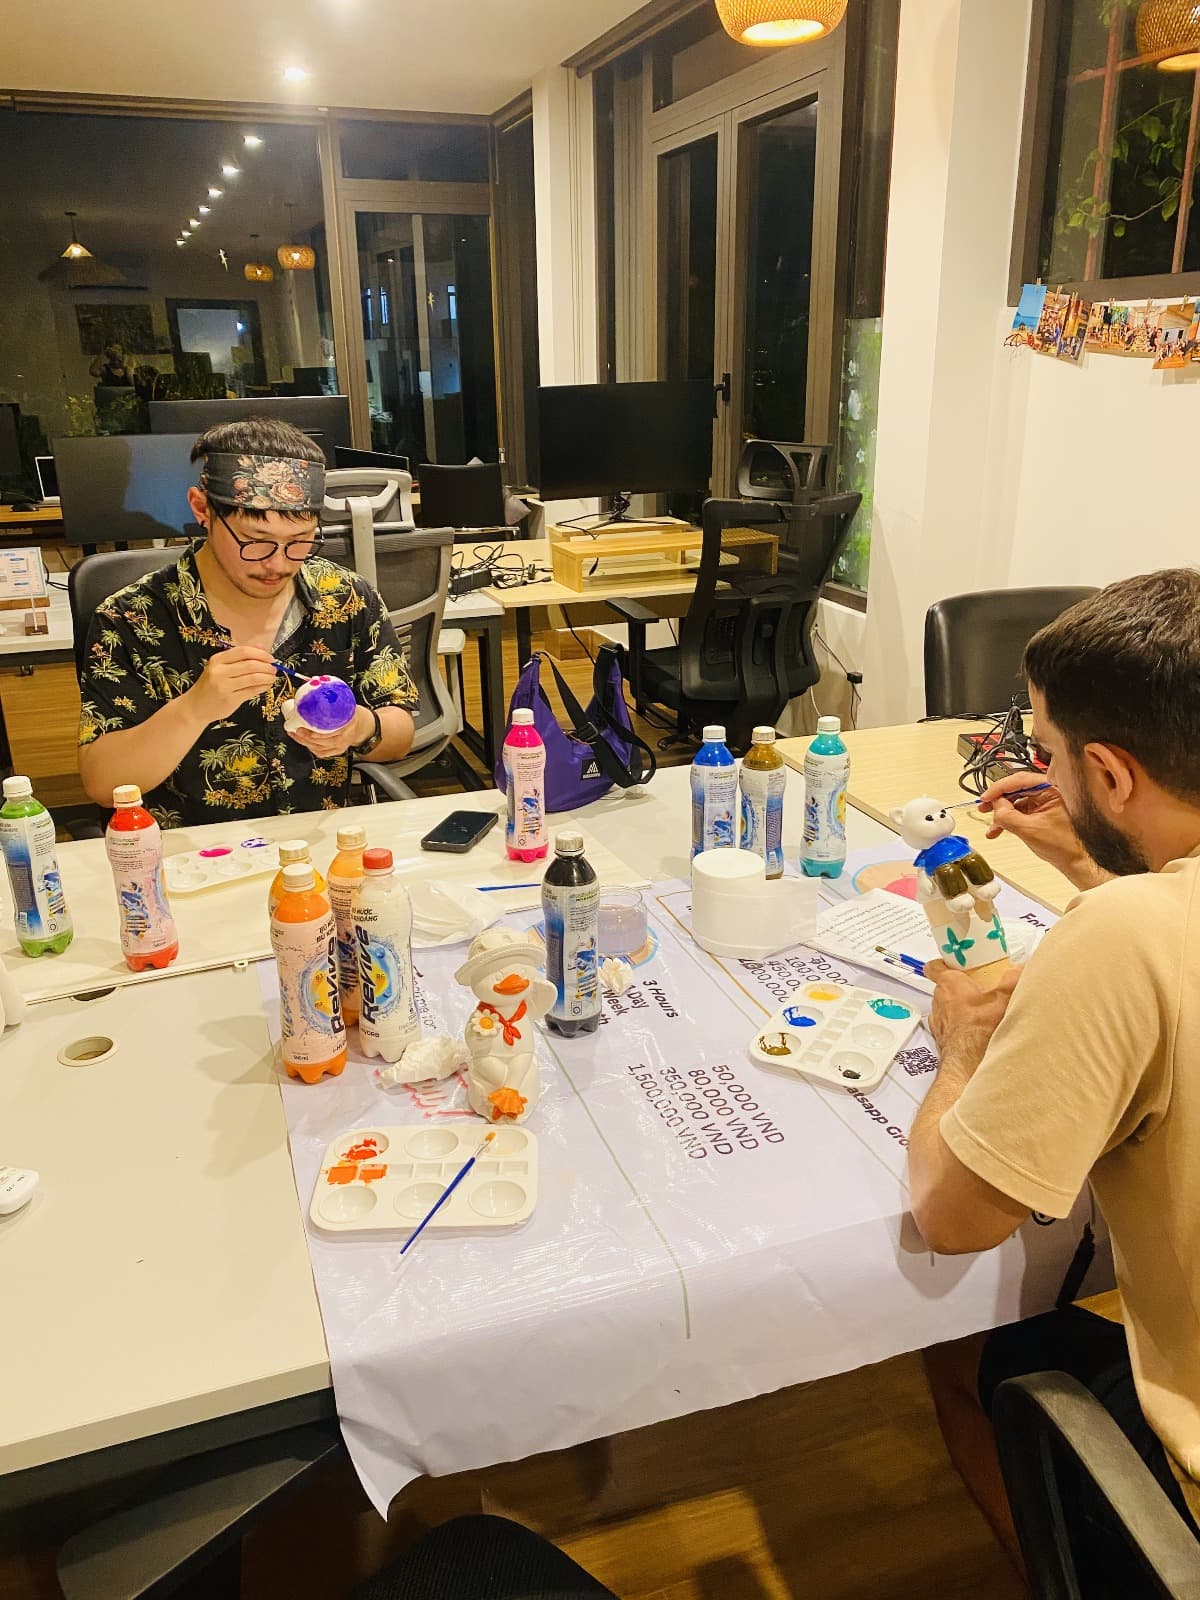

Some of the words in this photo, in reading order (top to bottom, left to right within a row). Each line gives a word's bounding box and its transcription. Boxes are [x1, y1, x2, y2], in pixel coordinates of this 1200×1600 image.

[601, 989, 631, 1016] Week
[625, 990, 649, 1010] Day
[649, 986, 679, 1018] Hours
[627, 1063, 684, 1128] 1,500,000
[676, 1126, 707, 1159] VND
[659, 1066, 709, 1120] 350,000
[700, 1122, 734, 1155] VND
[688, 1069, 734, 1116] 80,000
[726, 1117, 759, 1150] VND
[712, 1064, 758, 1111] 50,000
[752, 1112, 784, 1143] VND
[844, 1087, 888, 1124] atsapp
[886, 1126, 909, 1151] Gro
